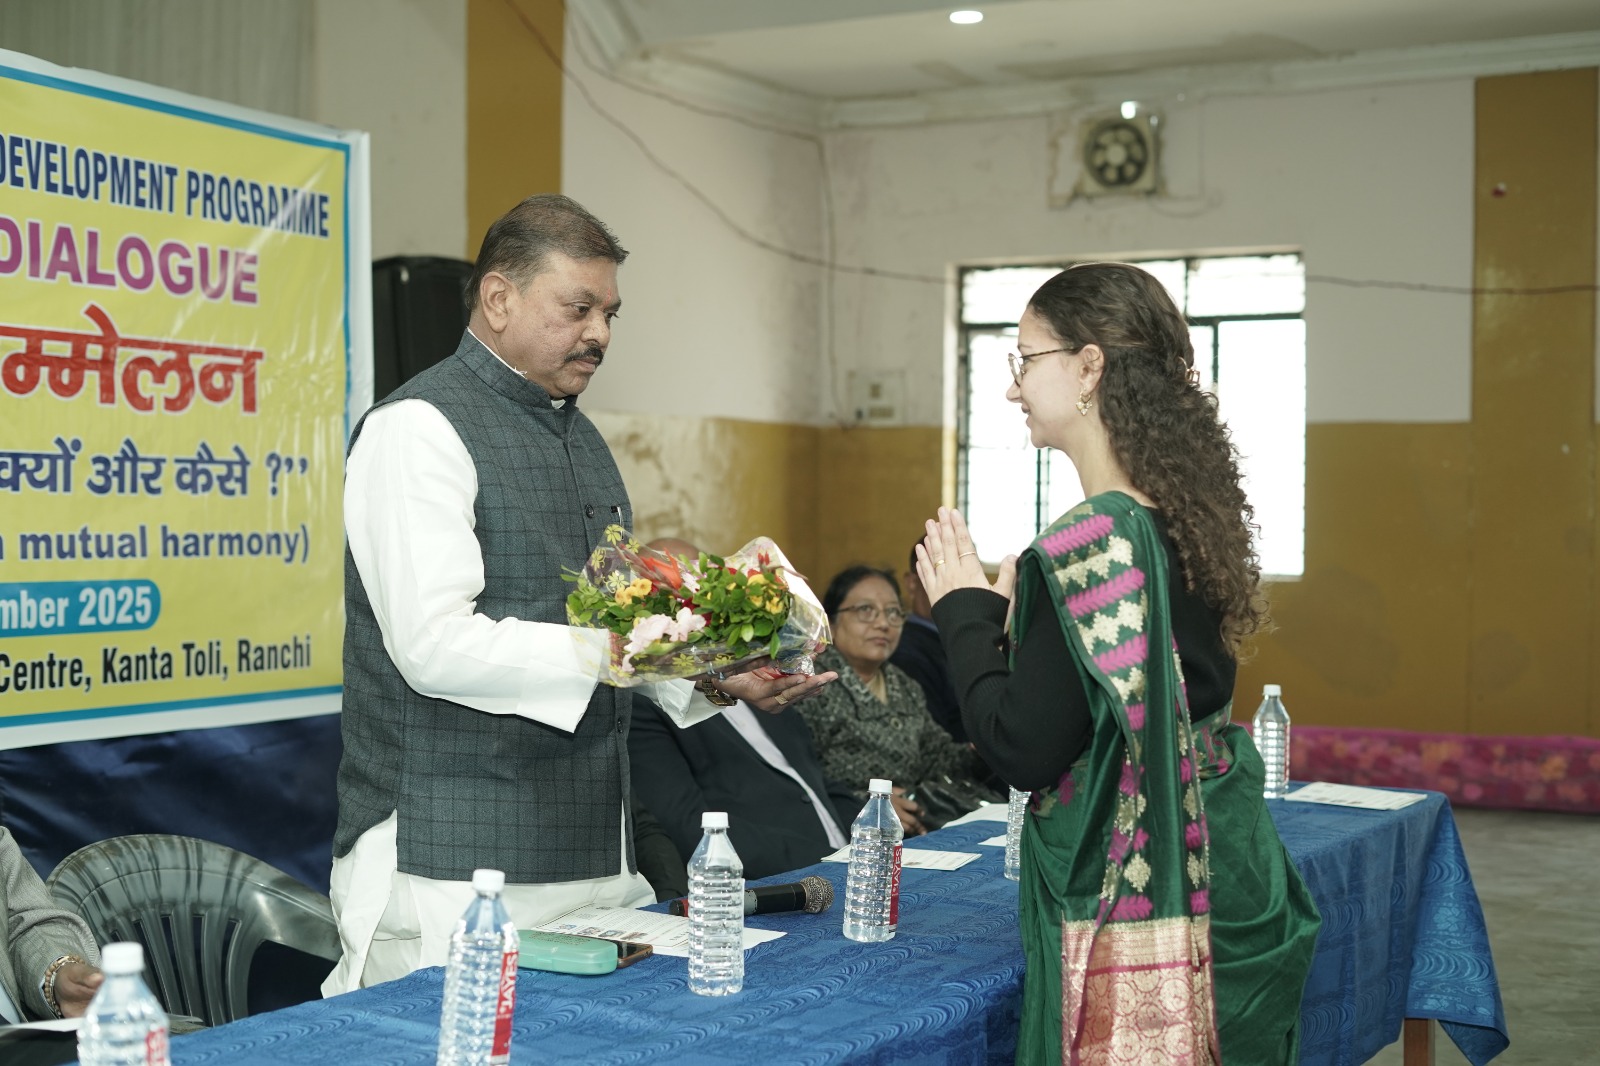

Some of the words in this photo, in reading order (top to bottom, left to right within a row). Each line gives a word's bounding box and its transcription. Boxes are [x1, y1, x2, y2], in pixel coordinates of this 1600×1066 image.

[187, 170, 330, 238] PROGRAMME
[87, 437, 166, 495] और
[174, 441, 251, 496] कैसे
[20, 525, 148, 560] mutual
[161, 524, 309, 563] harmony)
[78, 586, 151, 628] 2025
[102, 647, 173, 685] Kanta
[182, 641, 228, 681] Toli,
[237, 635, 311, 674] Ranchi
